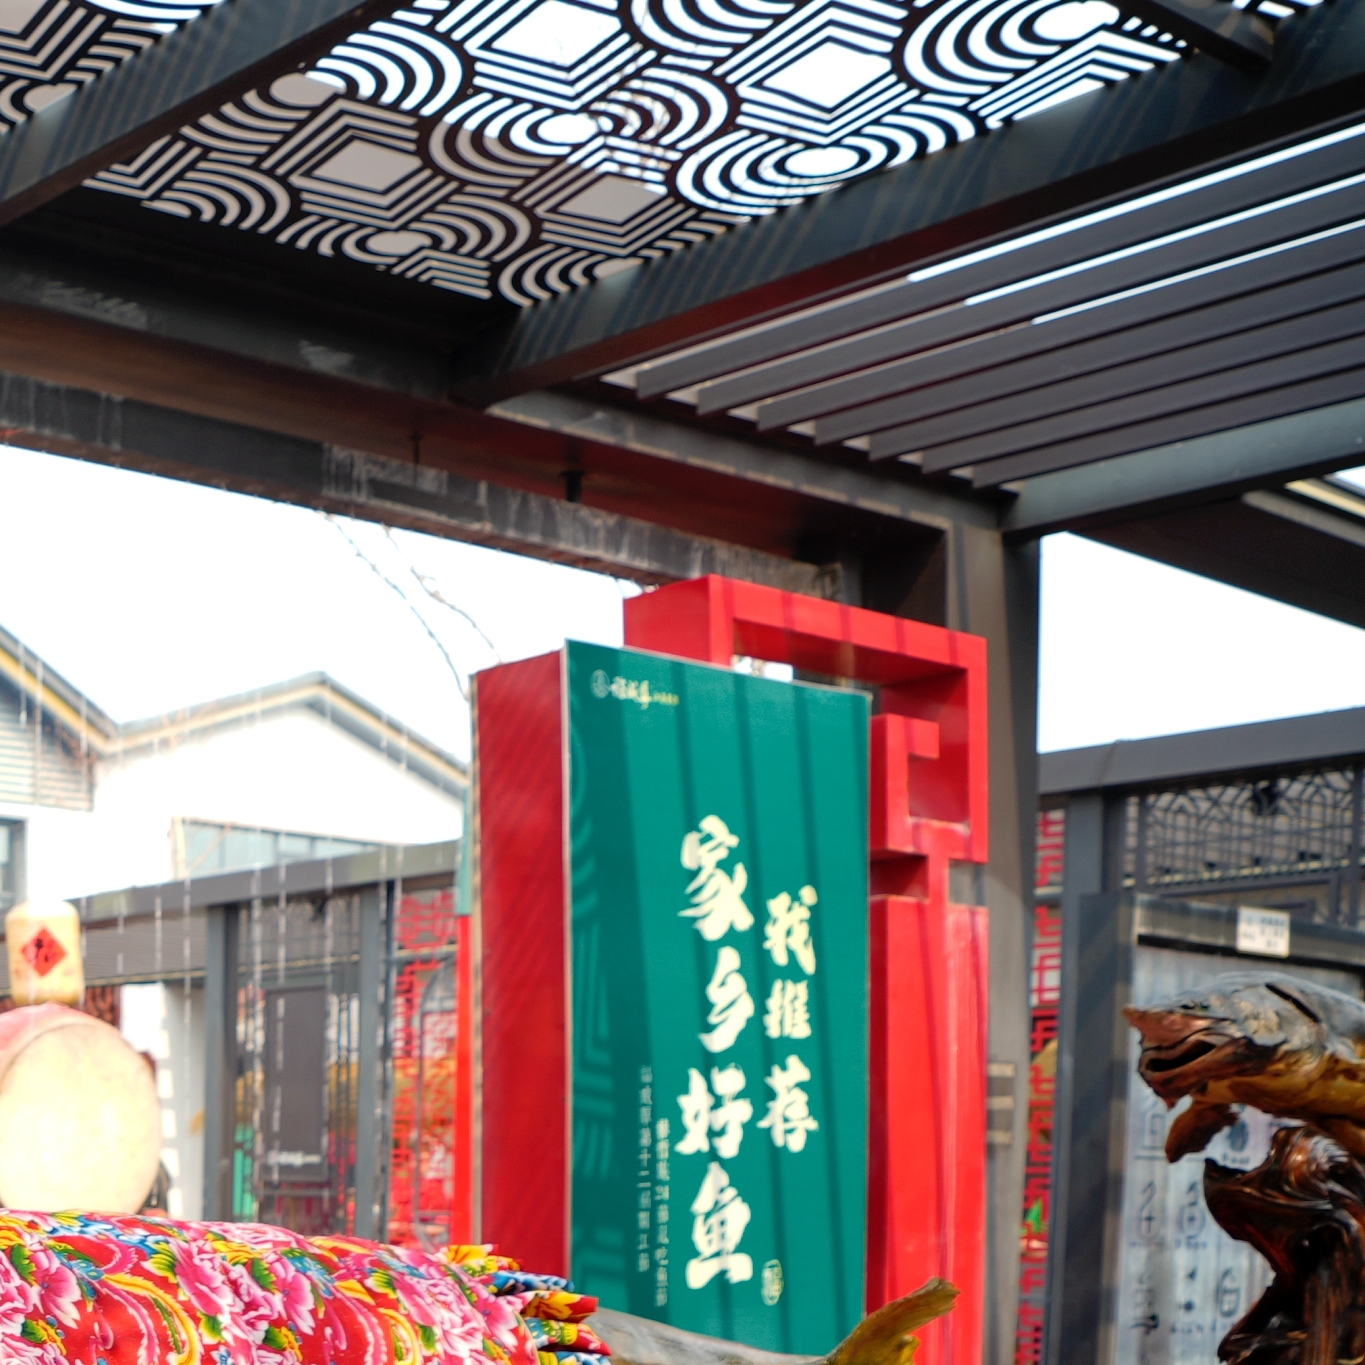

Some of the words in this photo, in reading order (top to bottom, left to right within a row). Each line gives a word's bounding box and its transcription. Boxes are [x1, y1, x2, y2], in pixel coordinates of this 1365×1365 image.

[675, 813, 756, 1290] 家乡好鱼
[756, 885, 819, 1153] 我推荐
